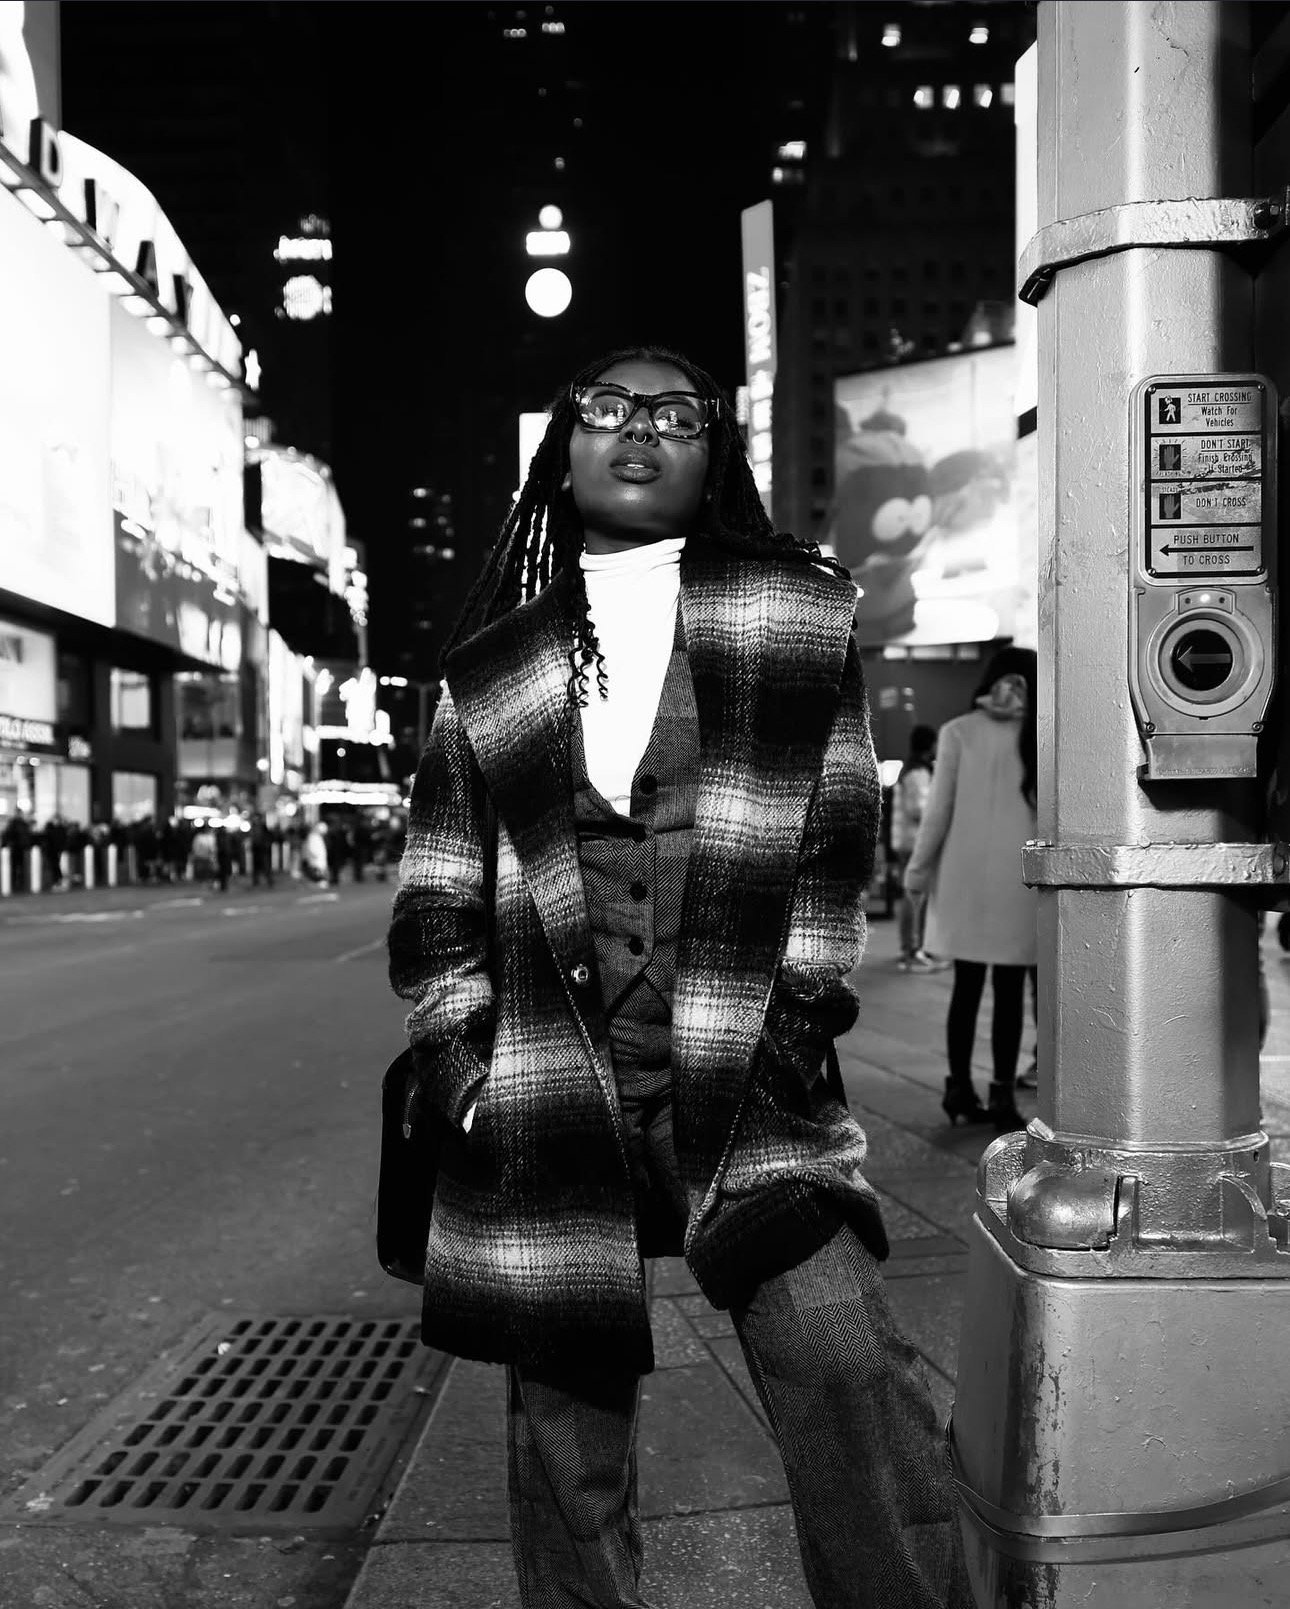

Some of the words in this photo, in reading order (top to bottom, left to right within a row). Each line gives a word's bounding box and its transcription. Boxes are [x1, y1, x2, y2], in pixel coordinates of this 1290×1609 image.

[1187, 392, 1210, 403] START
[1214, 391, 1252, 402] CROSSING
[1201, 405, 1223, 416] Watch
[1226, 405, 1238, 415] For
[1205, 417, 1234, 427] Vehicles
[1201, 439, 1223, 449] DON'T
[1227, 438, 1249, 449] START
[1196, 498, 1218, 508] DON'T
[1222, 497, 1246, 507] CROSS
[1173, 534, 1199, 545] PUSH
[1203, 533, 1240, 544] BUTTON
[1183, 555, 1195, 565] TO
[1199, 554, 1231, 565] CROSS
